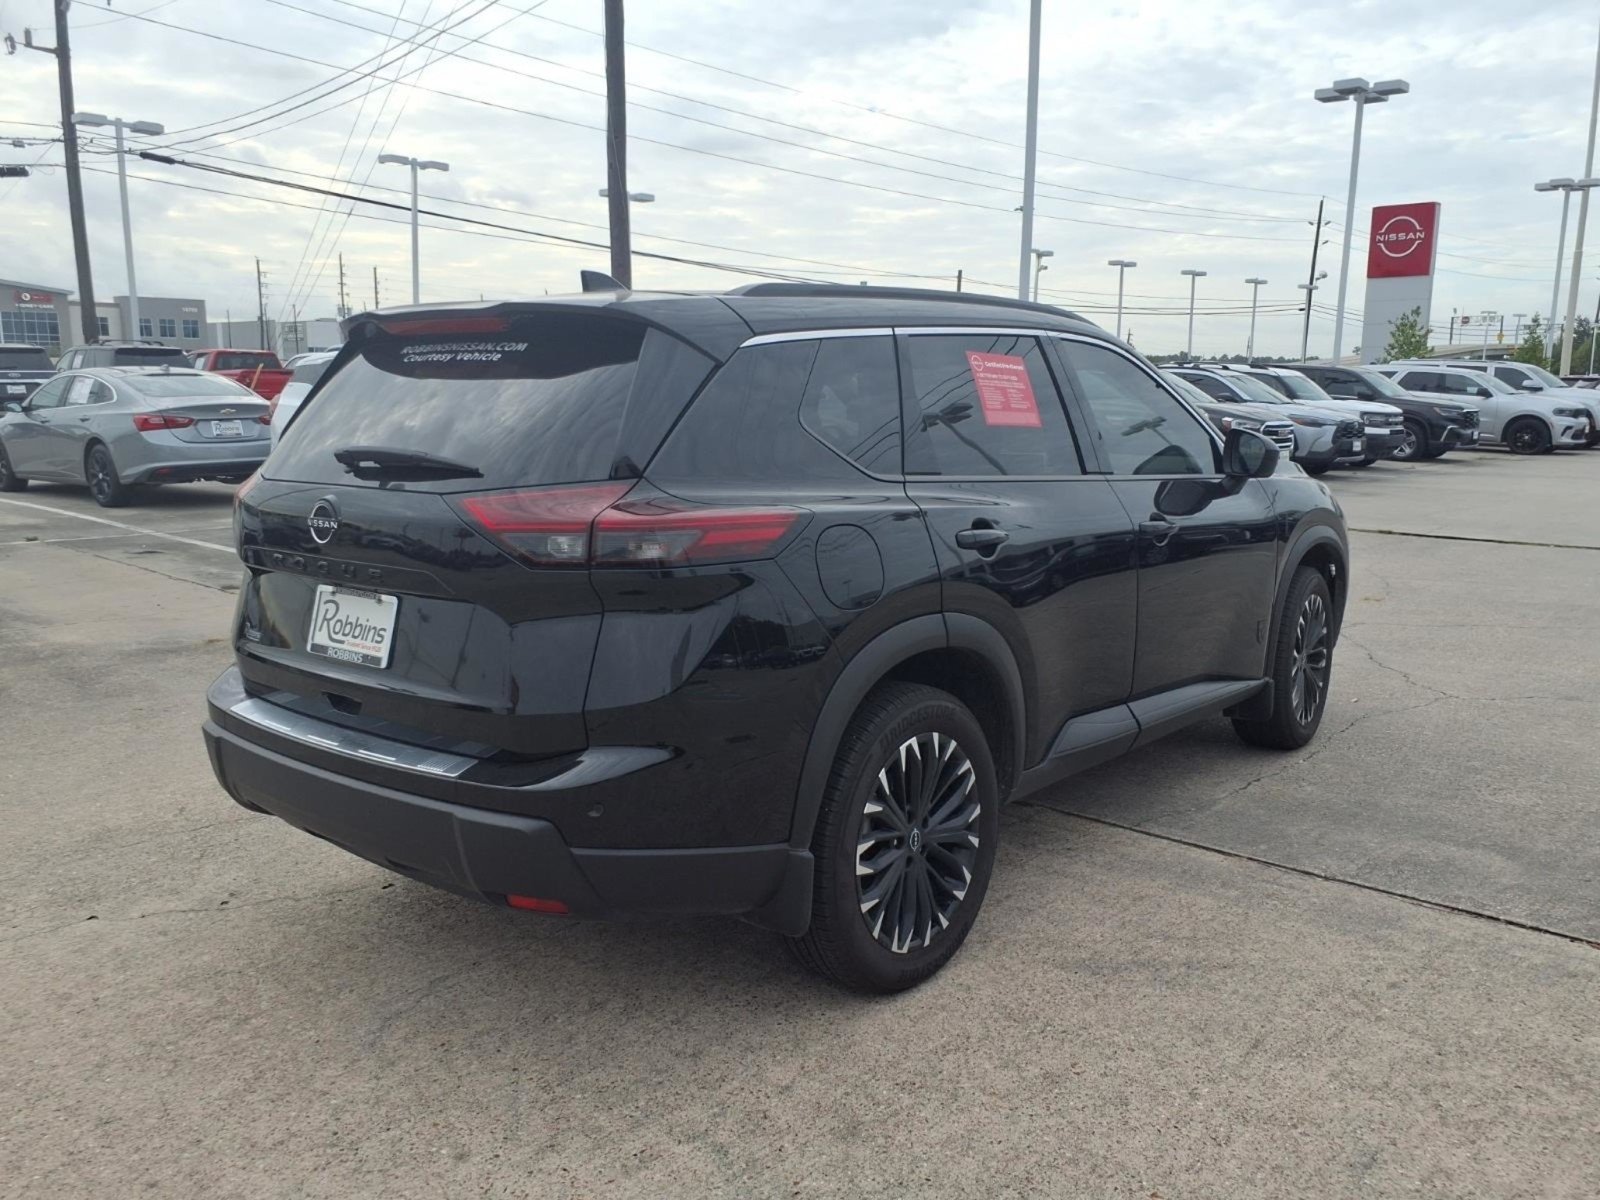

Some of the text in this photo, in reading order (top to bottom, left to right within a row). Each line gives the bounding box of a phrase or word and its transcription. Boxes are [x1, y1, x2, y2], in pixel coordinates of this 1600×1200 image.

[1376, 231, 1425, 242] NISSAN
[403, 351, 502, 363] Courtesy Vehicle
[308, 518, 338, 529] NSSAN
[318, 599, 387, 645] Robbins
[327, 647, 363, 663] ROBBINS
